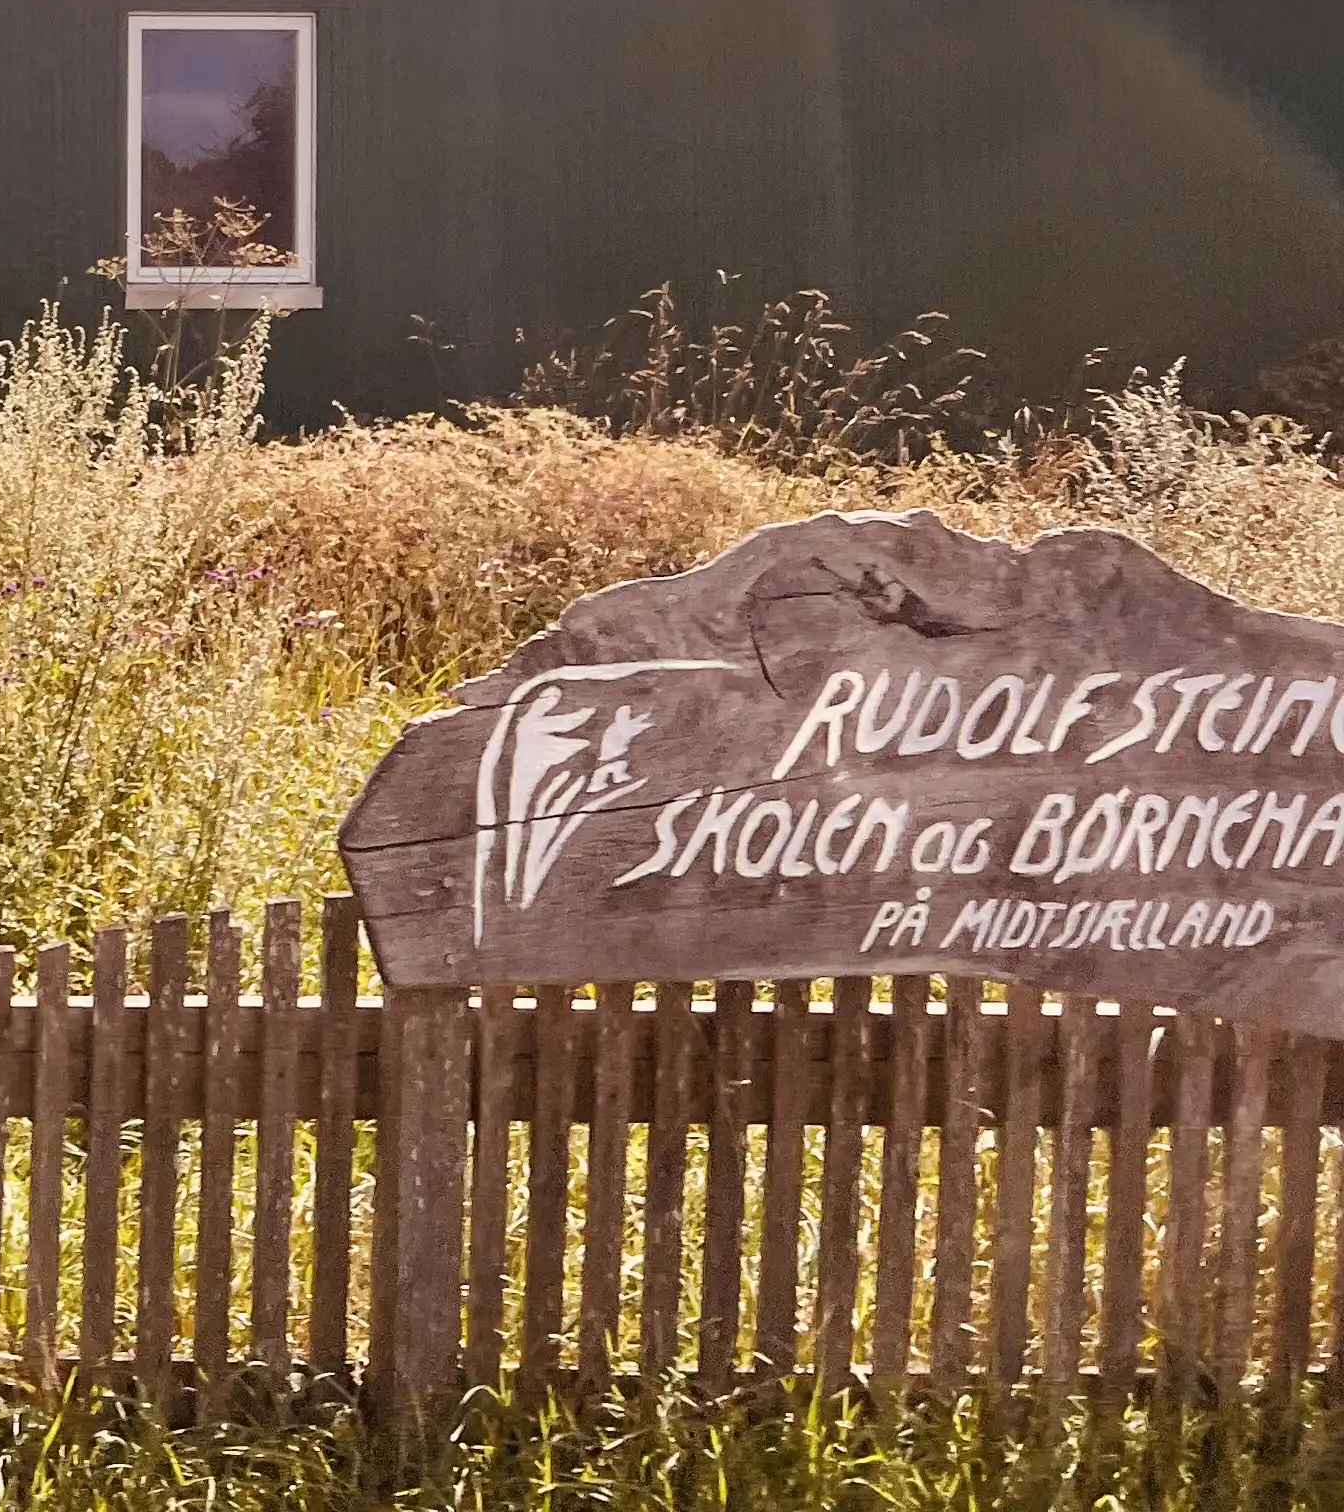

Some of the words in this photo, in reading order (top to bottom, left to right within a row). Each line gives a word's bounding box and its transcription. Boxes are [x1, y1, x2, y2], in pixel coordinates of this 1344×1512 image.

[771, 669, 1122, 780] RUDOLF
[1084, 667, 1344, 765] STEIN
[613, 786, 910, 887] SKOLEN
[860, 886, 932, 953] PÅ
[939, 899, 1275, 953] MIDTSJÆLLAND
